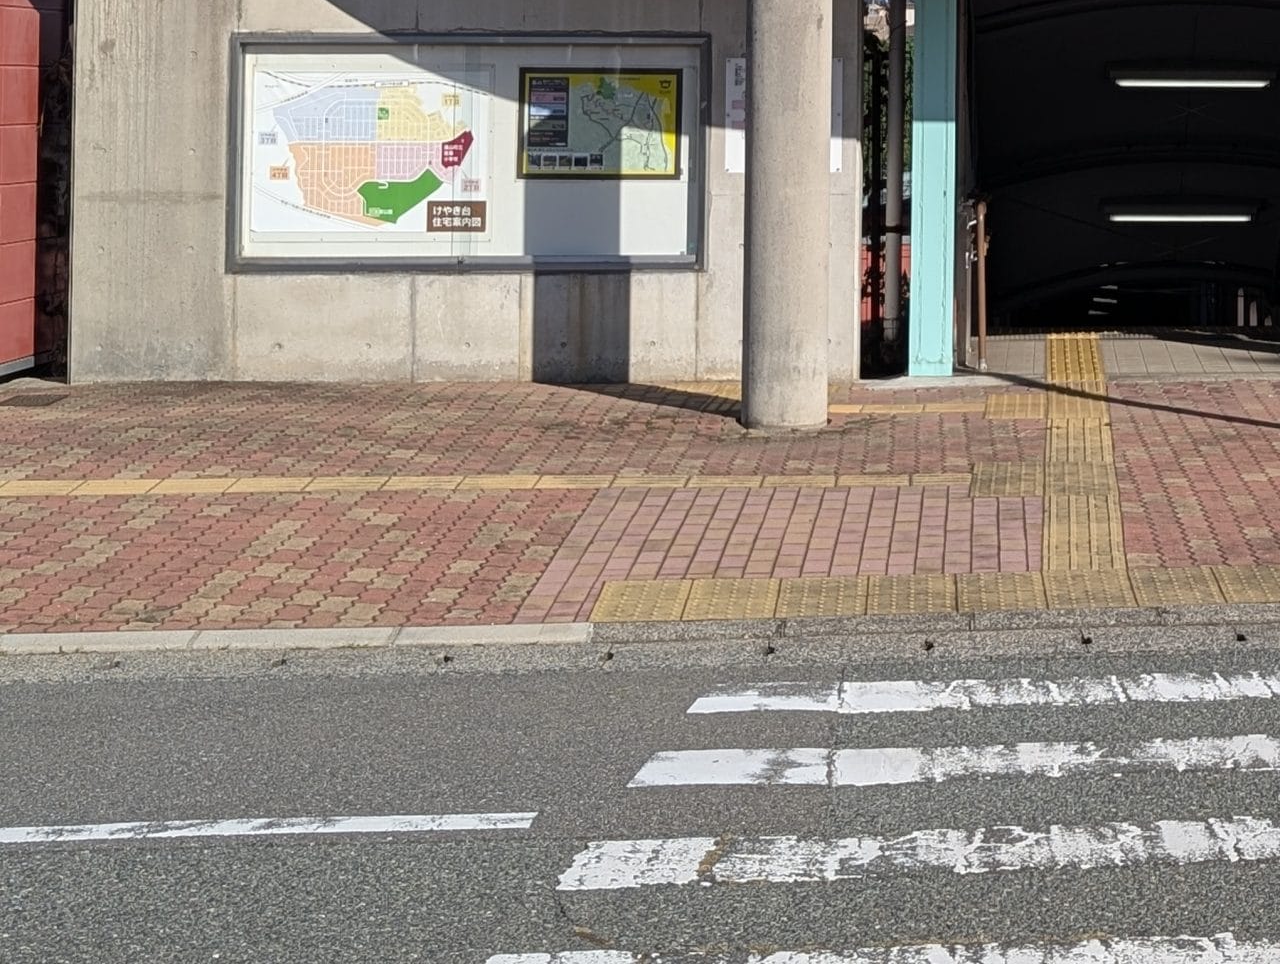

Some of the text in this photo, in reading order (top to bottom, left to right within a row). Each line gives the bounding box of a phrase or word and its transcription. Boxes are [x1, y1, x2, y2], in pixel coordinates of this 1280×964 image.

[432, 206, 471, 215] けやき台
[432, 217, 482, 227] 住宅案内図
